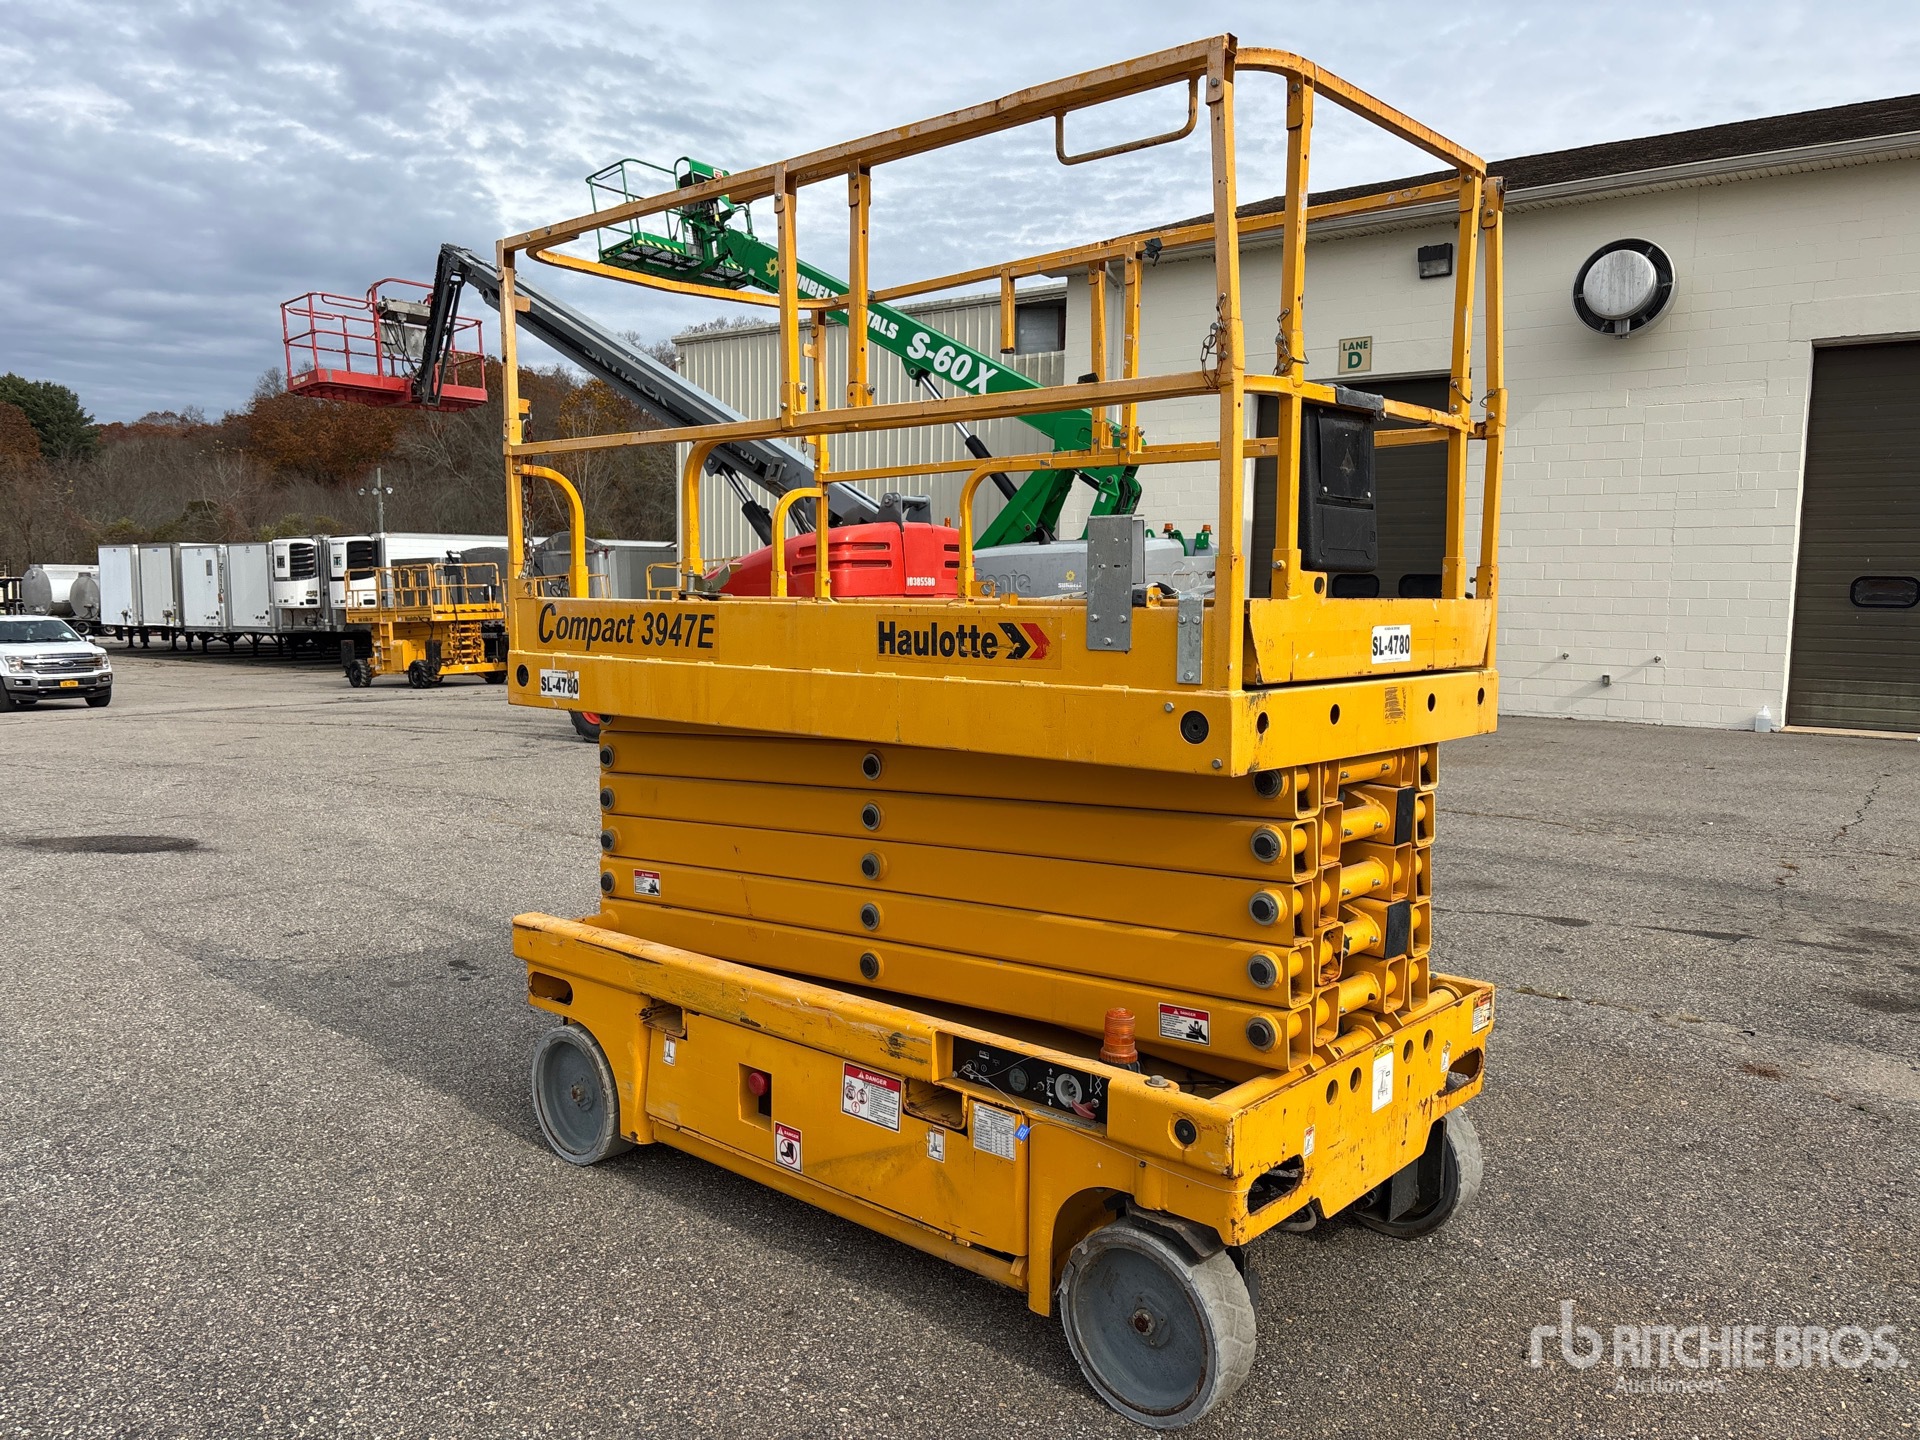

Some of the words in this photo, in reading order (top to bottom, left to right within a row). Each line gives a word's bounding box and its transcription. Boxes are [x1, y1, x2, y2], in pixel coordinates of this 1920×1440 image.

[797, 273, 840, 300] NBELT
[906, 331, 973, 382] S-60
[1342, 340, 1369, 352] LANE
[1347, 351, 1362, 369] D
[537, 602, 635, 651] Compact
[641, 611, 715, 650] 3947E
[877, 621, 998, 659] Haulotte
[1372, 633, 1410, 657] SL-4780
[541, 675, 579, 695] SL-4780
[864, 1073, 888, 1086] DANGER
